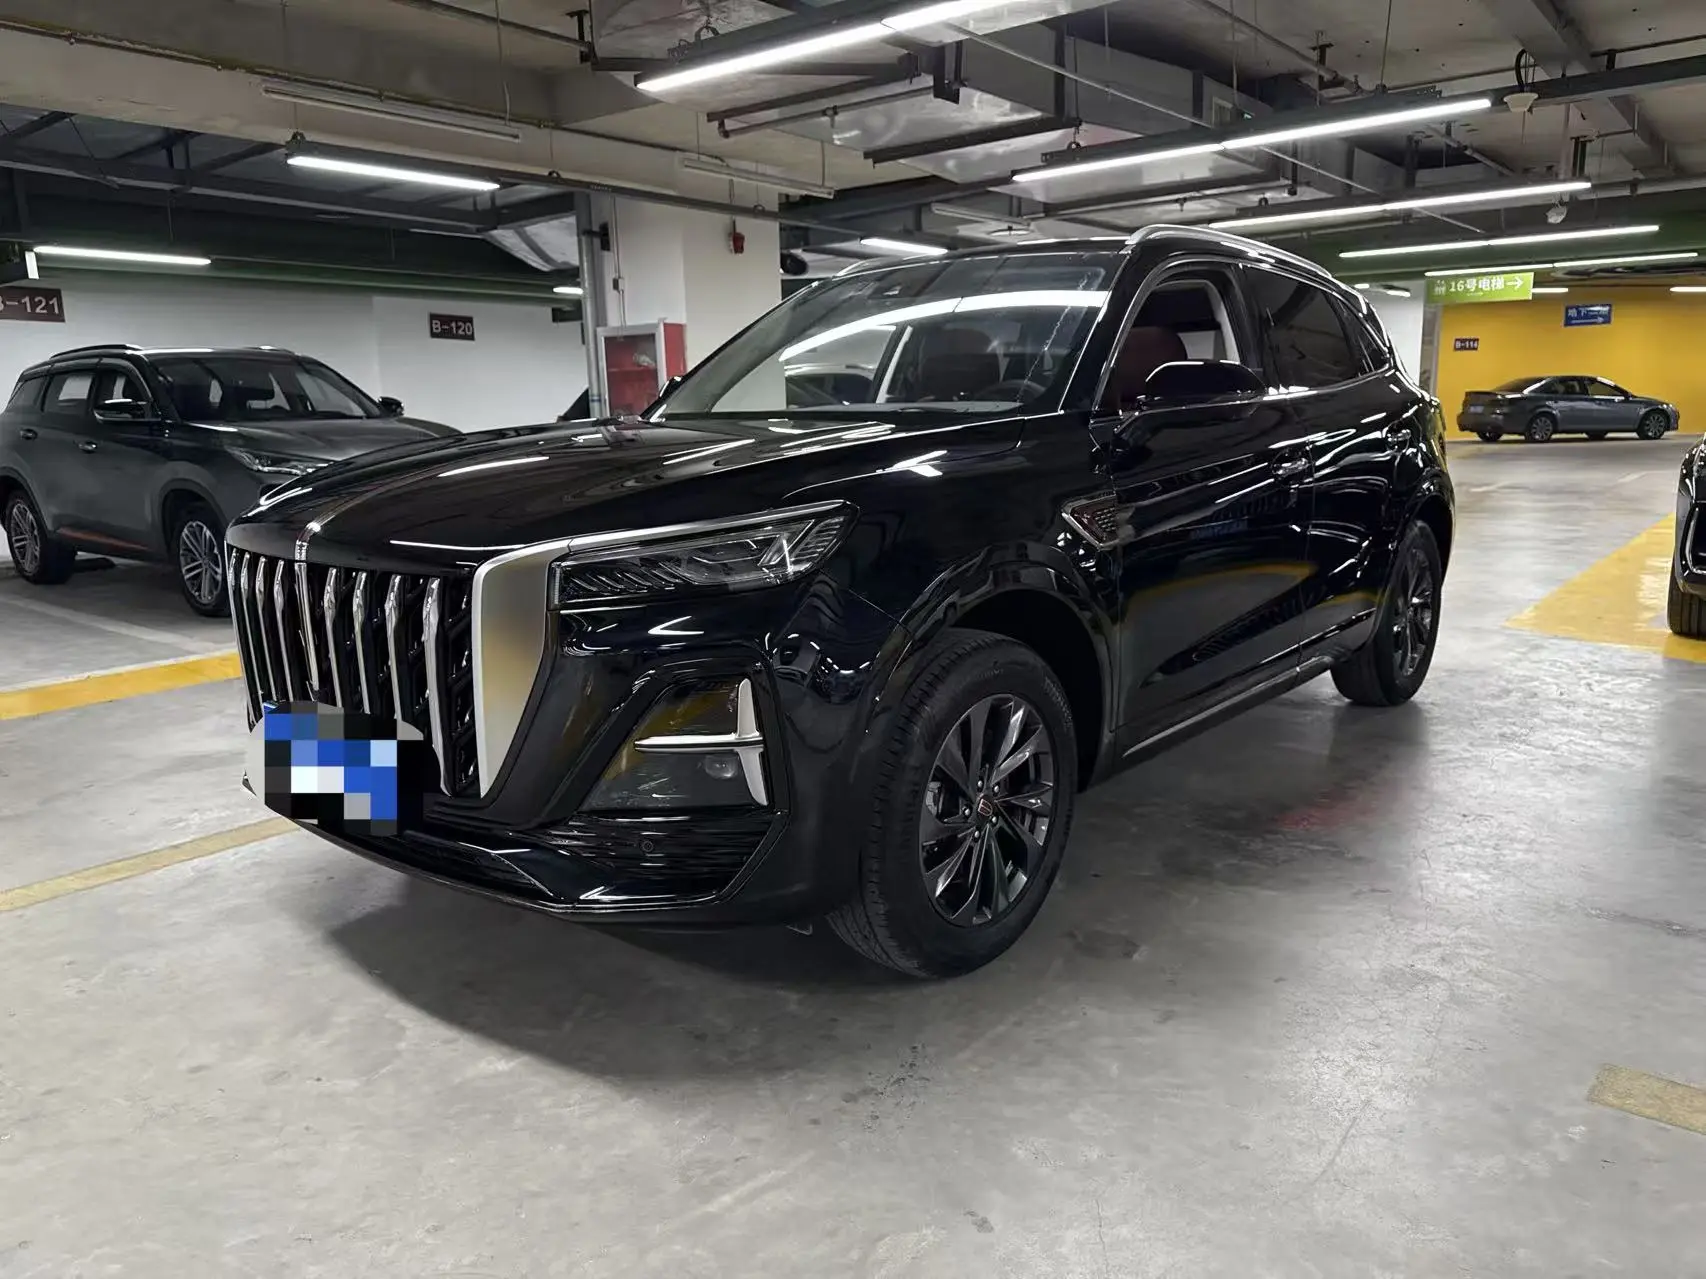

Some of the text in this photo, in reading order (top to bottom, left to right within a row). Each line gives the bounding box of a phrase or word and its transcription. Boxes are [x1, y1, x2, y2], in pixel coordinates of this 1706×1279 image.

[1449, 275, 1504, 292] 16号电梯
[432, 319, 473, 335] B-120
